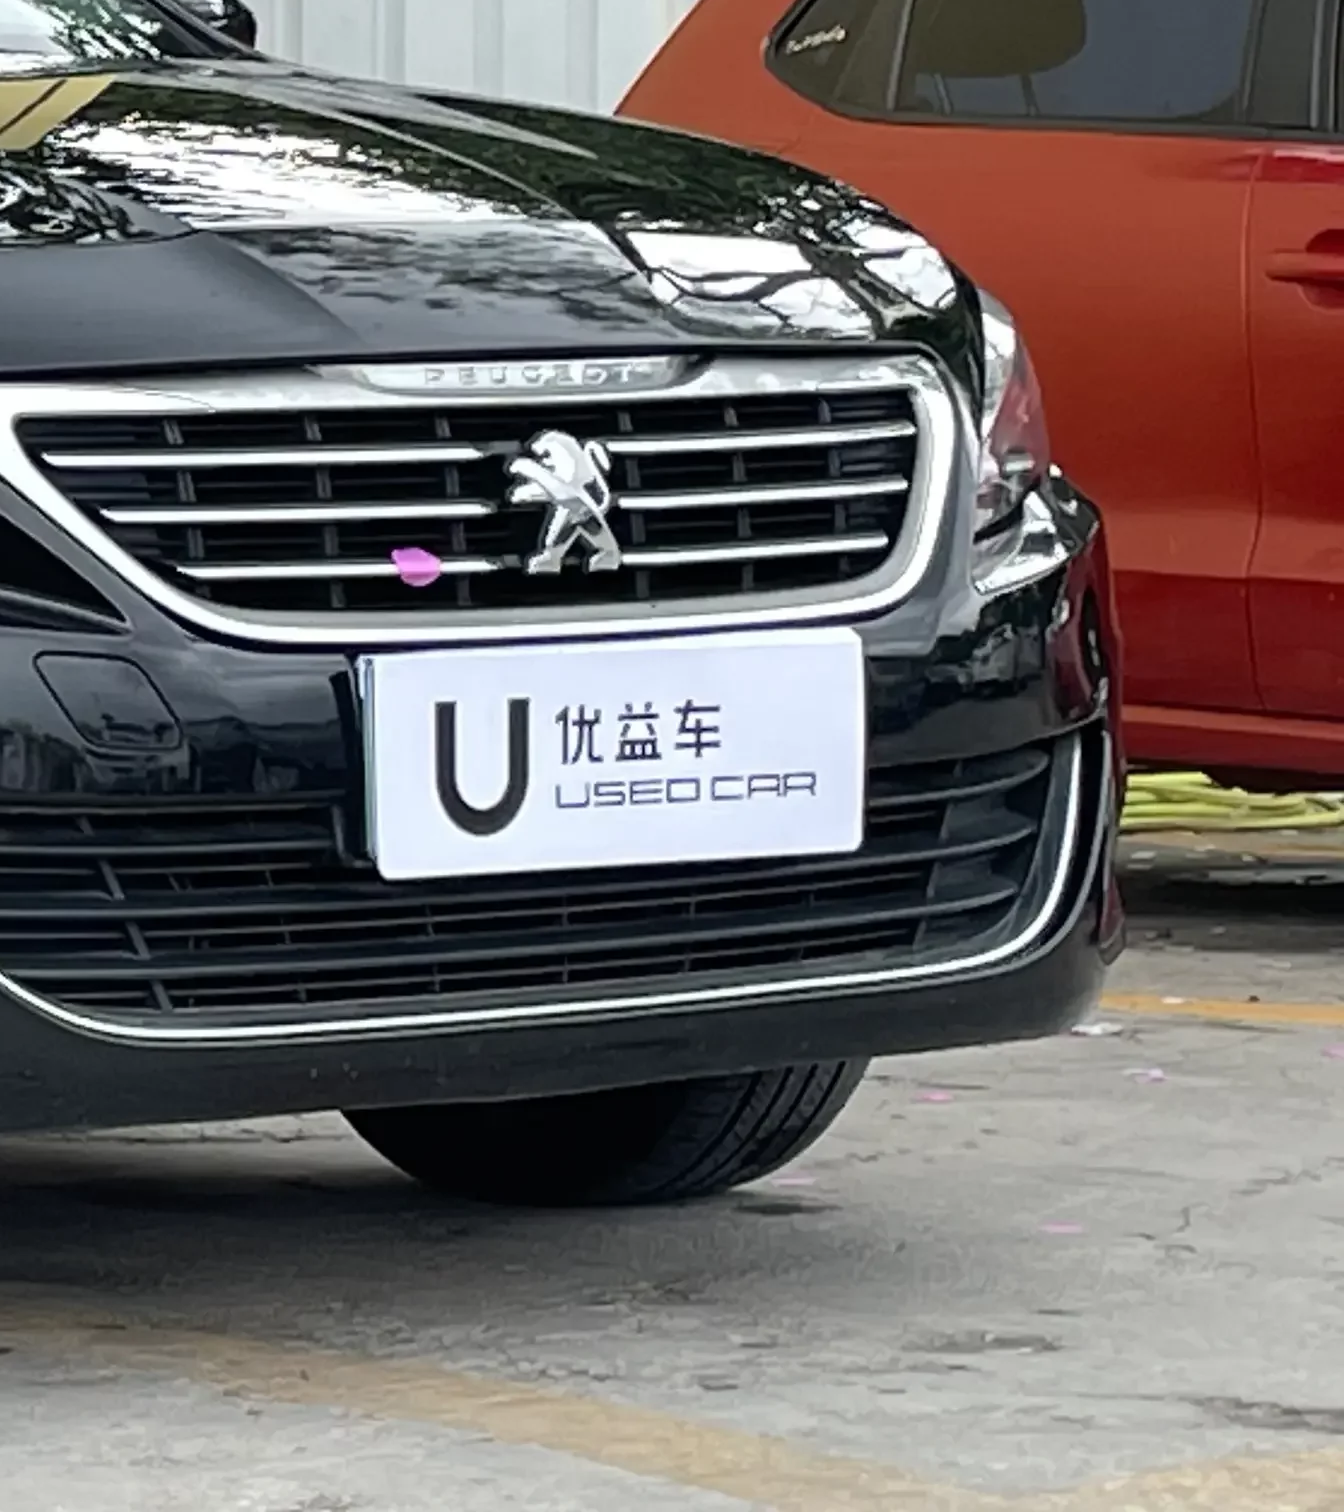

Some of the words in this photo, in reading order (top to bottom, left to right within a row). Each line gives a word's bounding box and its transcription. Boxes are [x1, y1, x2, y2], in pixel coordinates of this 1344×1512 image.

[423, 361, 638, 387] PEUGEOT
[555, 699, 722, 765] 优益车
[555, 778, 701, 809] USED
[711, 772, 817, 801] CAR
